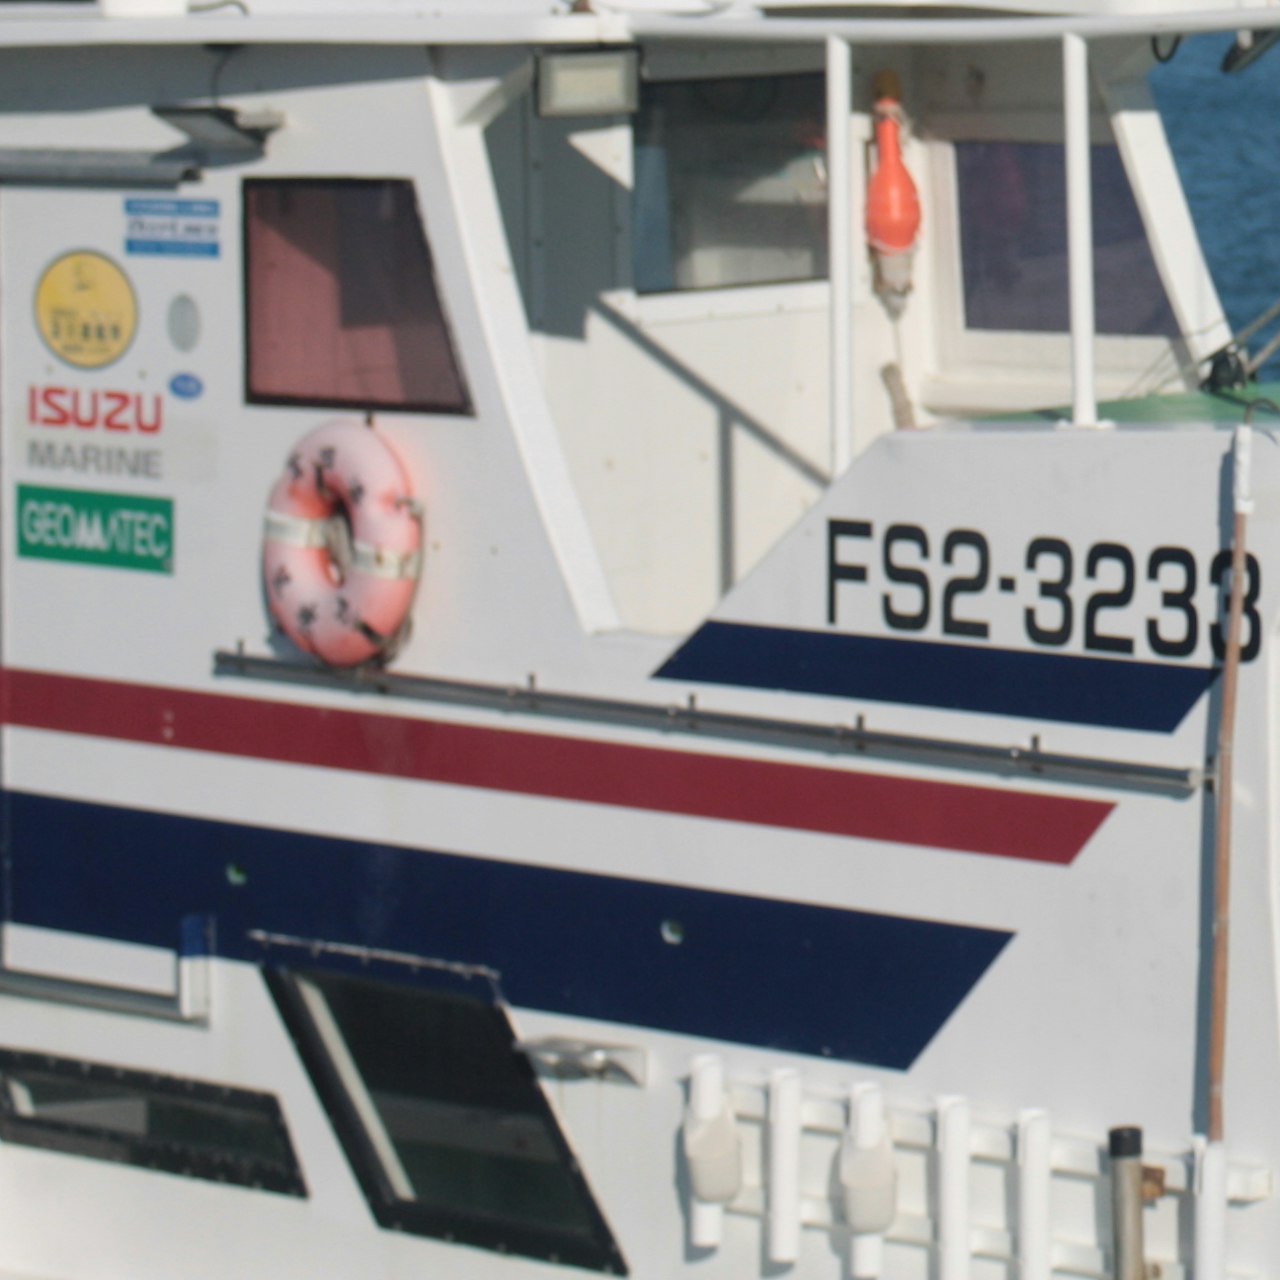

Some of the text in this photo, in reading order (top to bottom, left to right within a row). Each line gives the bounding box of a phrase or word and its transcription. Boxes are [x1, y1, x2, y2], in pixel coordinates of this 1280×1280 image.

[28, 385, 163, 434] ISUZU
[27, 440, 163, 479] MARINE
[827, 517, 1262, 663] FS2-3233
